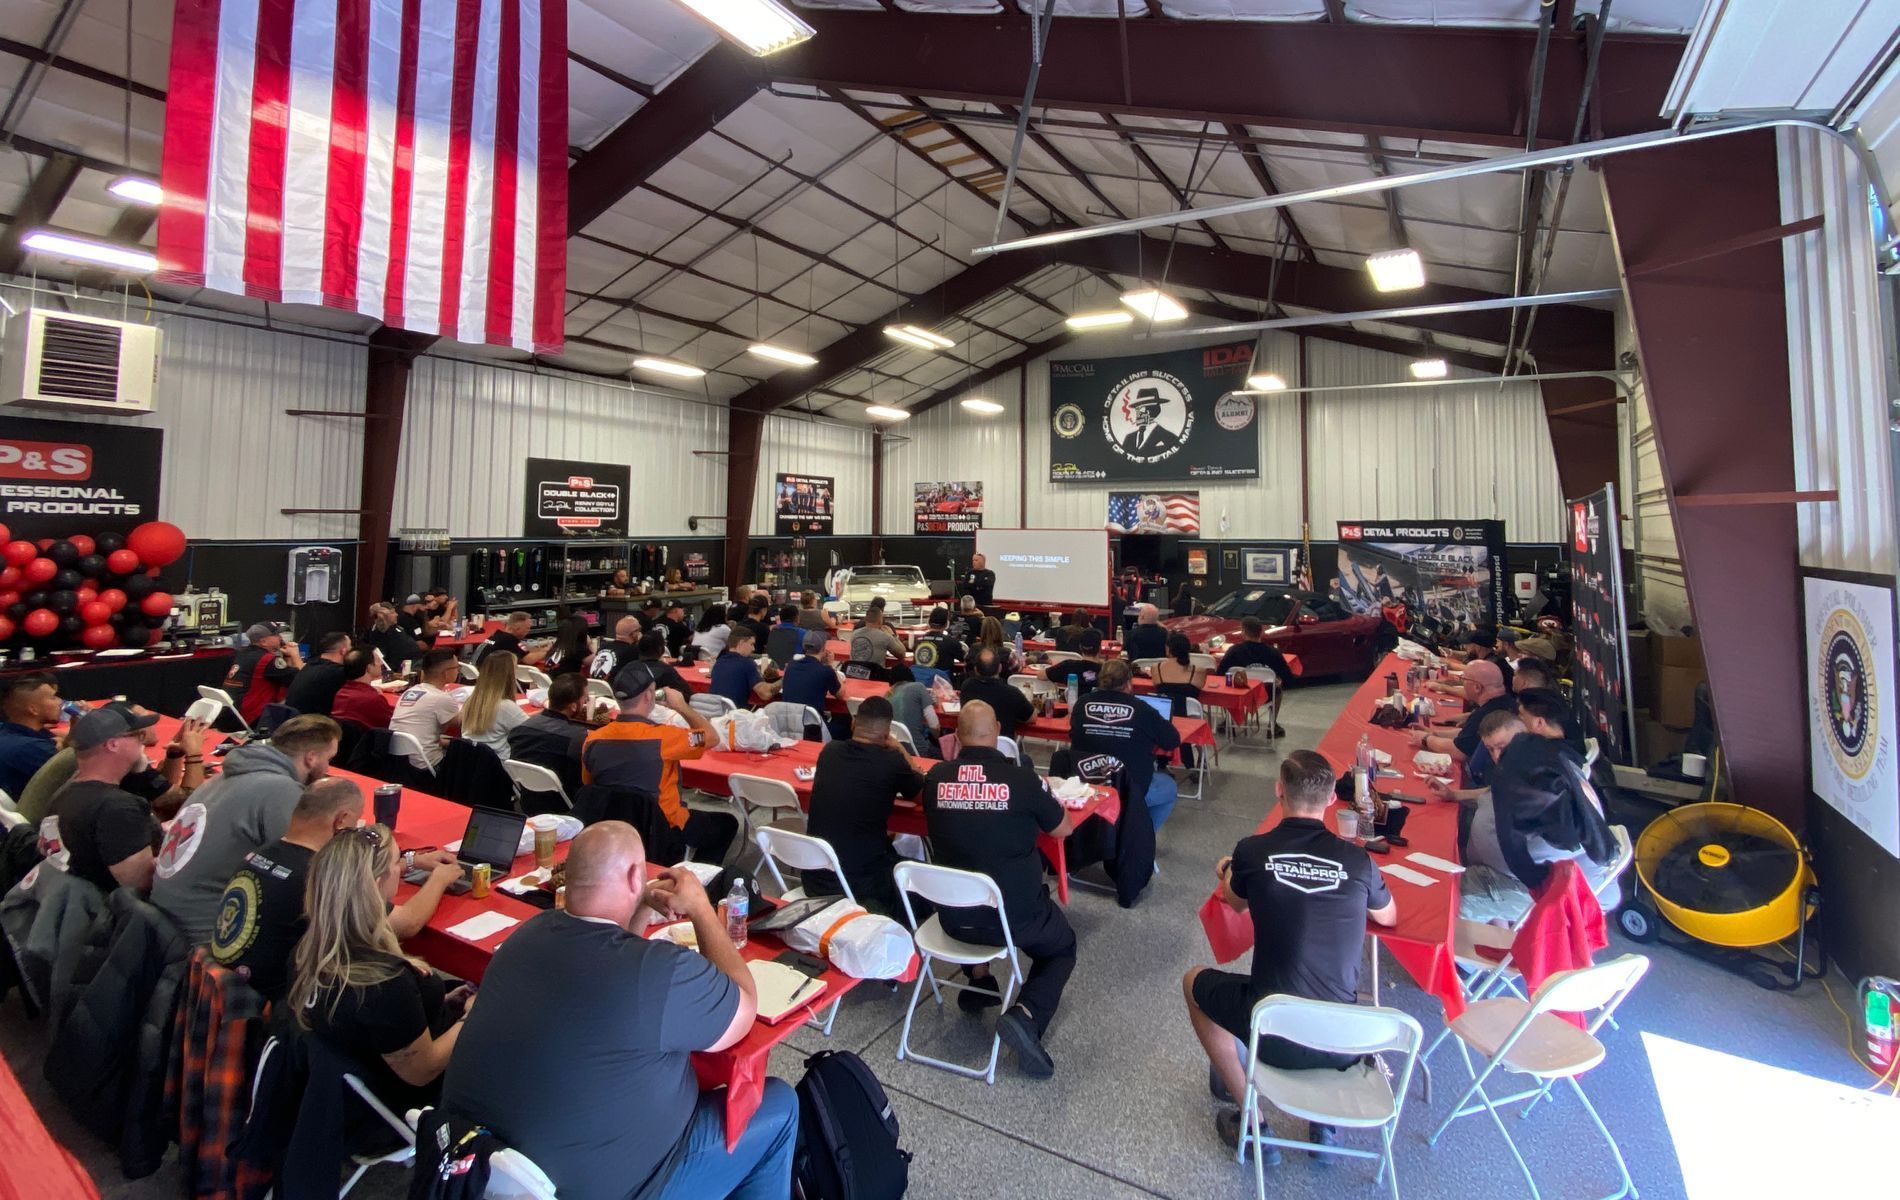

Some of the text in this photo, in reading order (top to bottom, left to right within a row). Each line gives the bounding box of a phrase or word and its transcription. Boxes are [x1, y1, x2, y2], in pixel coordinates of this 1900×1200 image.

[1203, 344, 1254, 369] IDA
[1104, 370, 1193, 409] DETAILING SUCCESS
[1102, 415, 1115, 443] HOME
[1126, 452, 1146, 464] THE
[1147, 445, 1181, 464] DETAIL
[1178, 410, 1195, 445] MAFIA
[570, 479, 591, 488] P&S
[0, 484, 124, 500] ESSIONAL
[543, 489, 607, 499] DOUBLE BLACK
[7, 501, 141, 515] PRODUCTS
[916, 522, 928, 531] P&S
[947, 521, 980, 532] PRODUCTS
[1341, 526, 1450, 538] P&S DETAIL PRODUCTS
[999, 554, 1070, 564] KEEPING THIS SIMPLE
[1417, 553, 1474, 564] DOUBLE BLACK
[1088, 704, 1130, 717] GARVIN
[958, 764, 987, 783] HTL
[936, 782, 1010, 802] DETAILING
[937, 800, 1009, 811] NATIONWIDE DETAILER
[1264, 862, 1349, 880] DETAILPROS
[1299, 861, 1313, 869] THE
